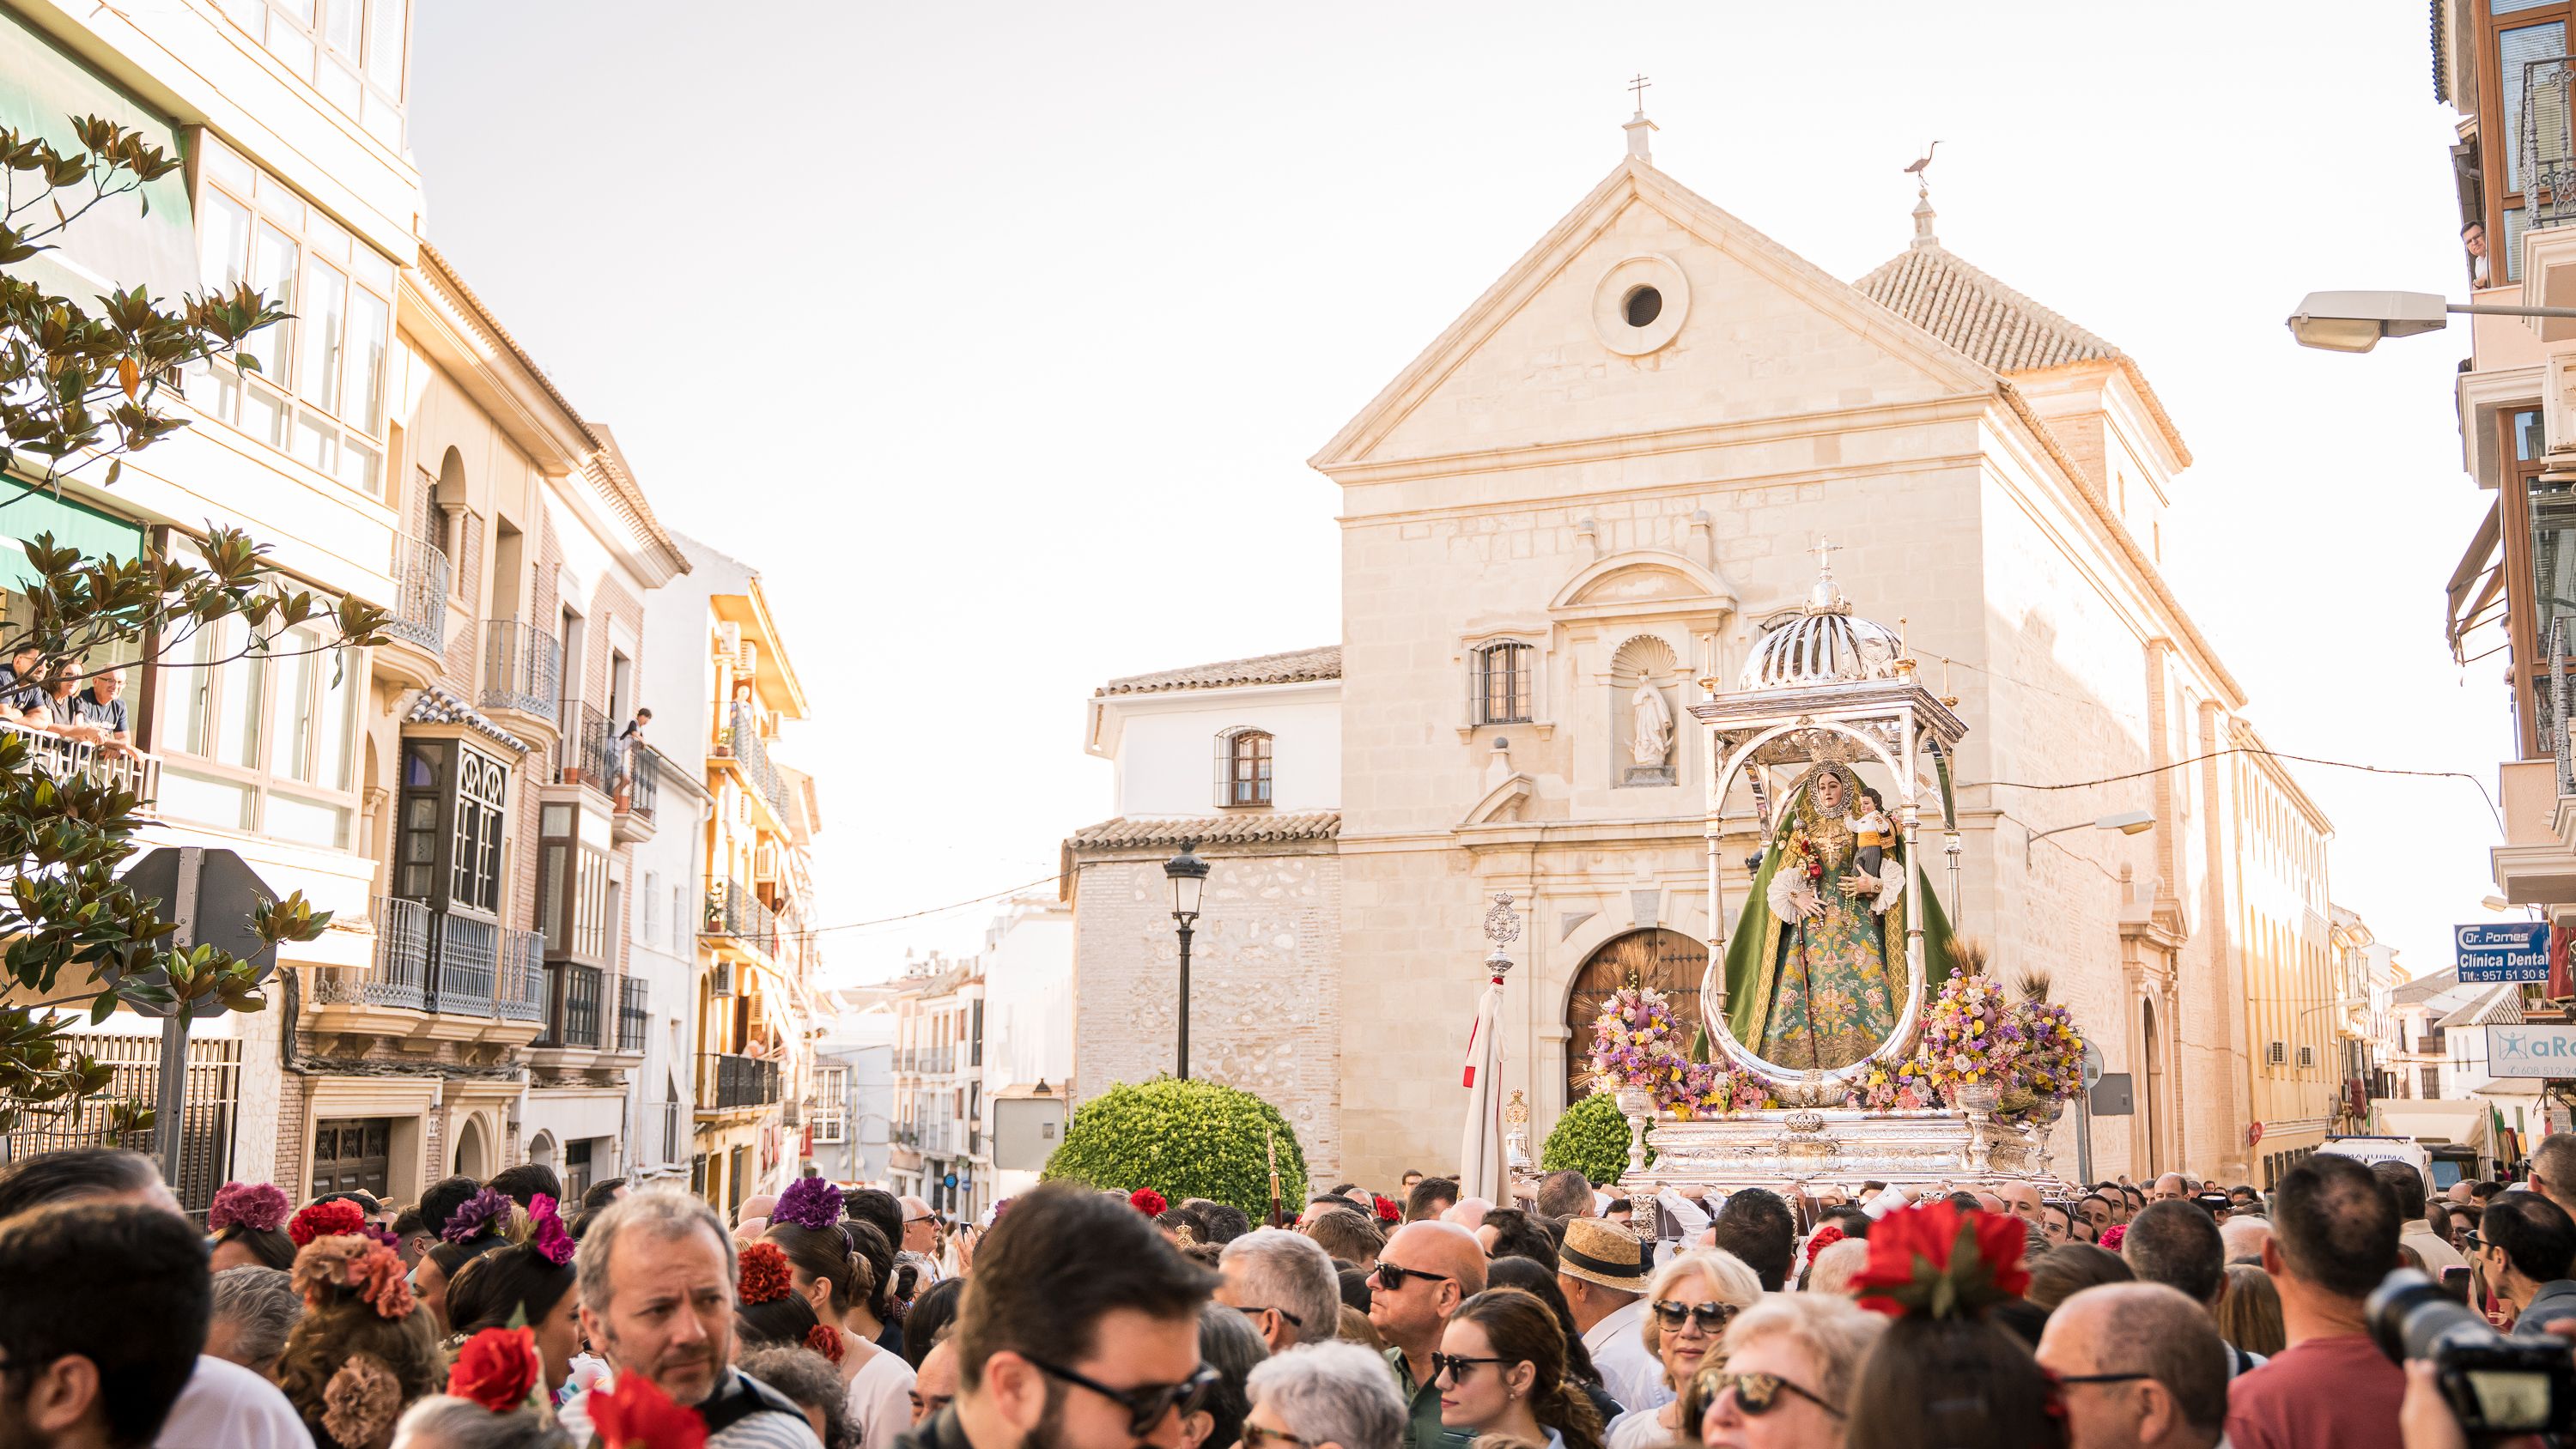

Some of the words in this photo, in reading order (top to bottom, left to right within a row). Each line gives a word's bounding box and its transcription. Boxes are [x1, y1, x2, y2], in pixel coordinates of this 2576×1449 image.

[2466, 933, 2482, 943] Dr.
[2486, 932, 2529, 943] Pomes
[2460, 953, 2503, 968] Clínica
[2507, 951, 2549, 967] Dental
[2482, 971, 2501, 981] 957
[2506, 970, 2518, 980] 51
[2522, 969, 2536, 979] 30
[2522, 1066, 2539, 1076] 608
[2543, 1066, 2561, 1076] 512
